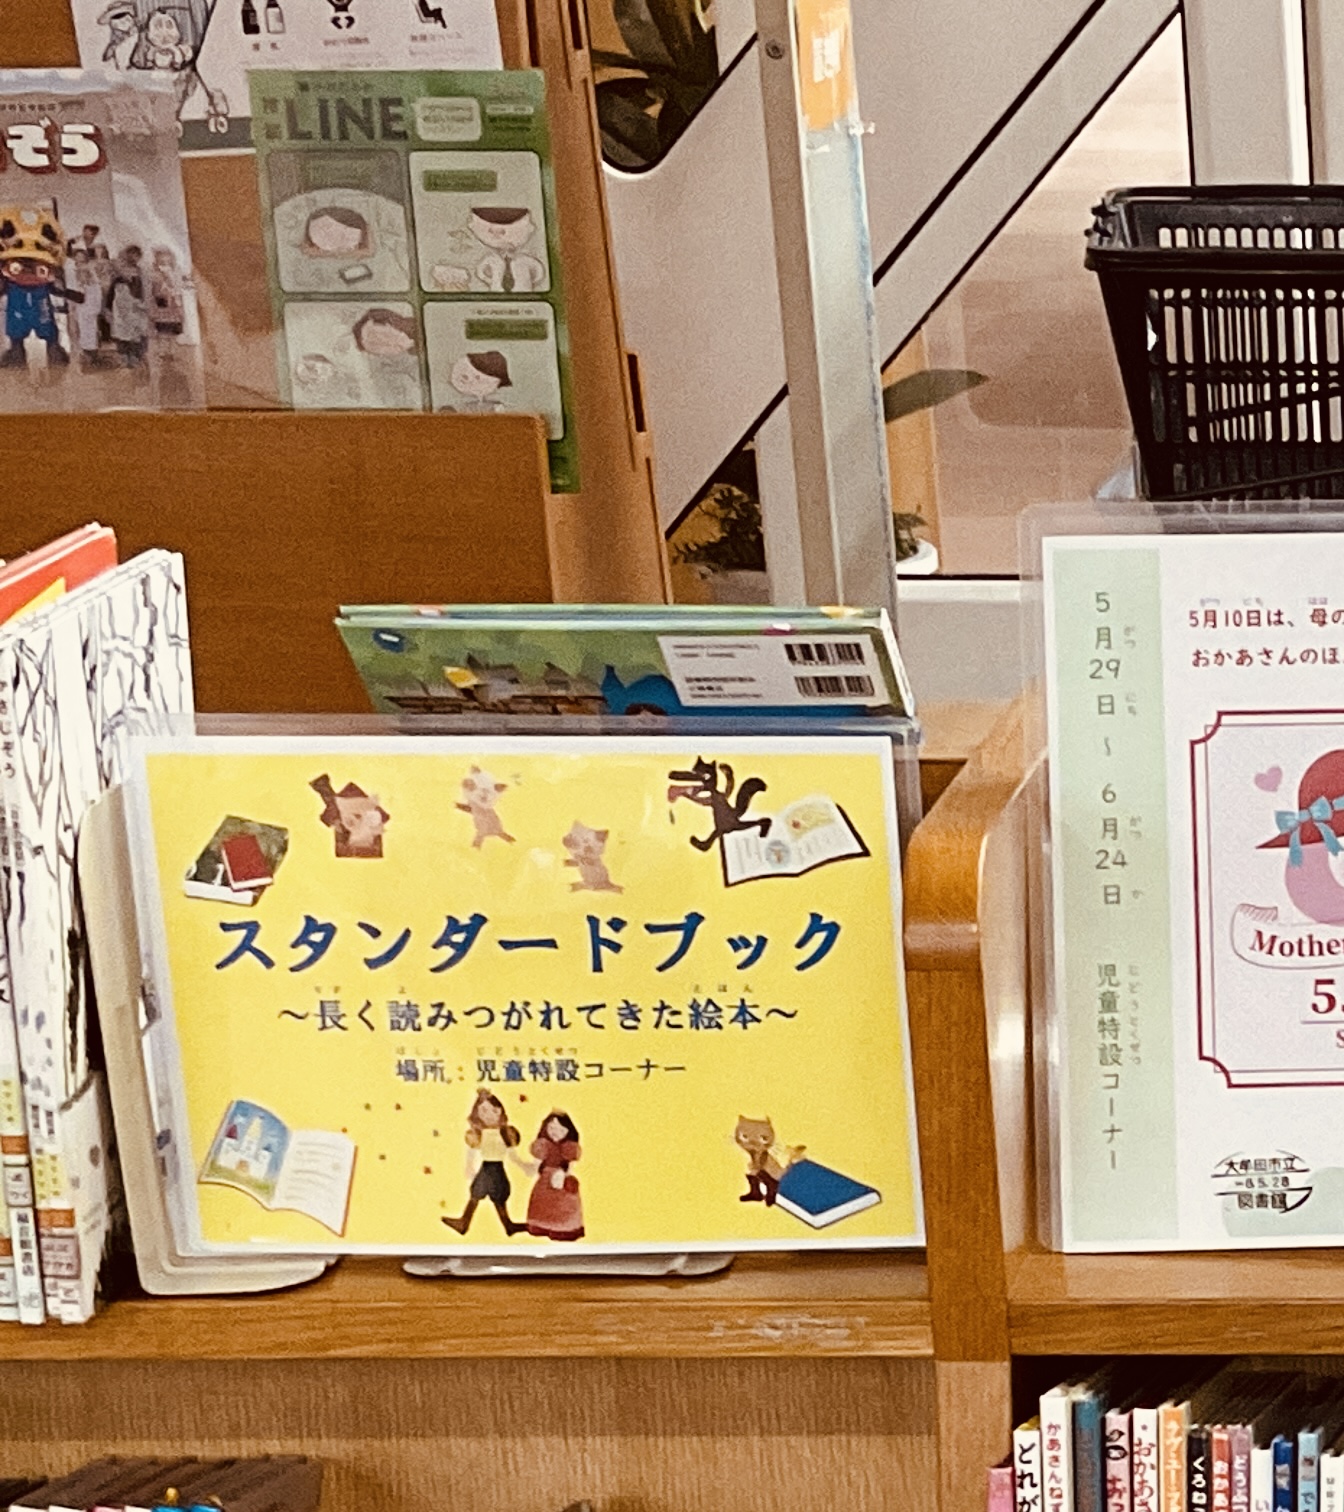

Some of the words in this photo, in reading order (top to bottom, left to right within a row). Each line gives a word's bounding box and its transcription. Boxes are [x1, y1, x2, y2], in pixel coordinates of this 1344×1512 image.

[285, 97, 408, 142] LINE
[213, 910, 844, 975] スタンダードブック
[475, 1057, 689, 1084] 児童特設コーナー
[1096, 962, 1124, 1171] 児童特設コーナー
